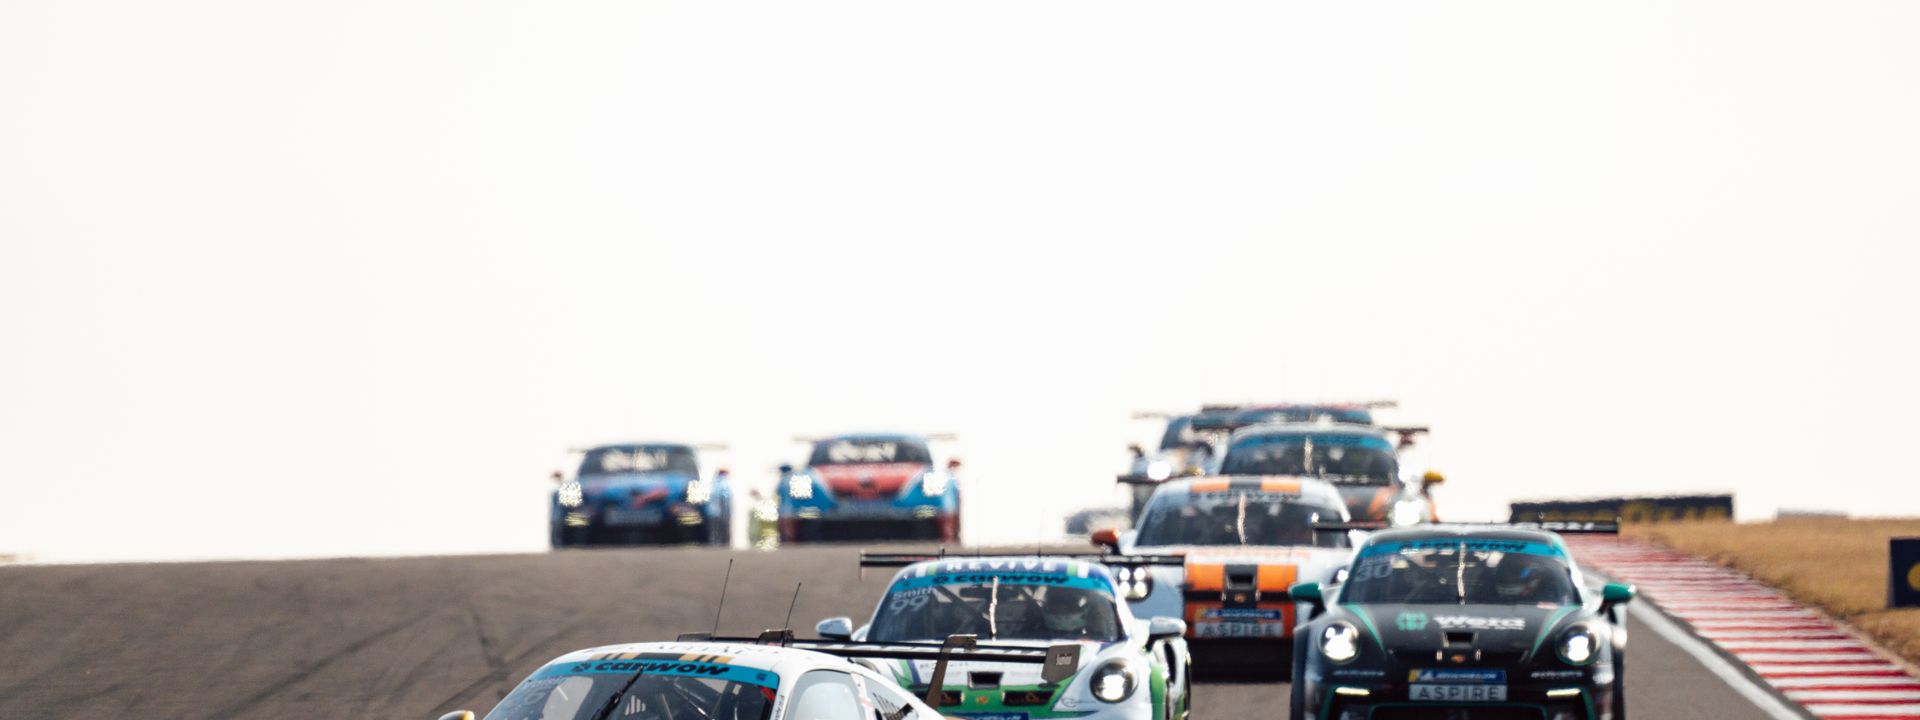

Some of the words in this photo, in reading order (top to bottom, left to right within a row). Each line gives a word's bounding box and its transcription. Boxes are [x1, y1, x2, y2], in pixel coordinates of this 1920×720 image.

[954, 574, 1070, 584] carwow
[892, 586, 933, 601] Smith
[890, 594, 930, 615] 99
[1202, 622, 1276, 637] ASPIRE
[595, 661, 731, 676] carwow
[1419, 685, 1500, 699] ASPIRE
